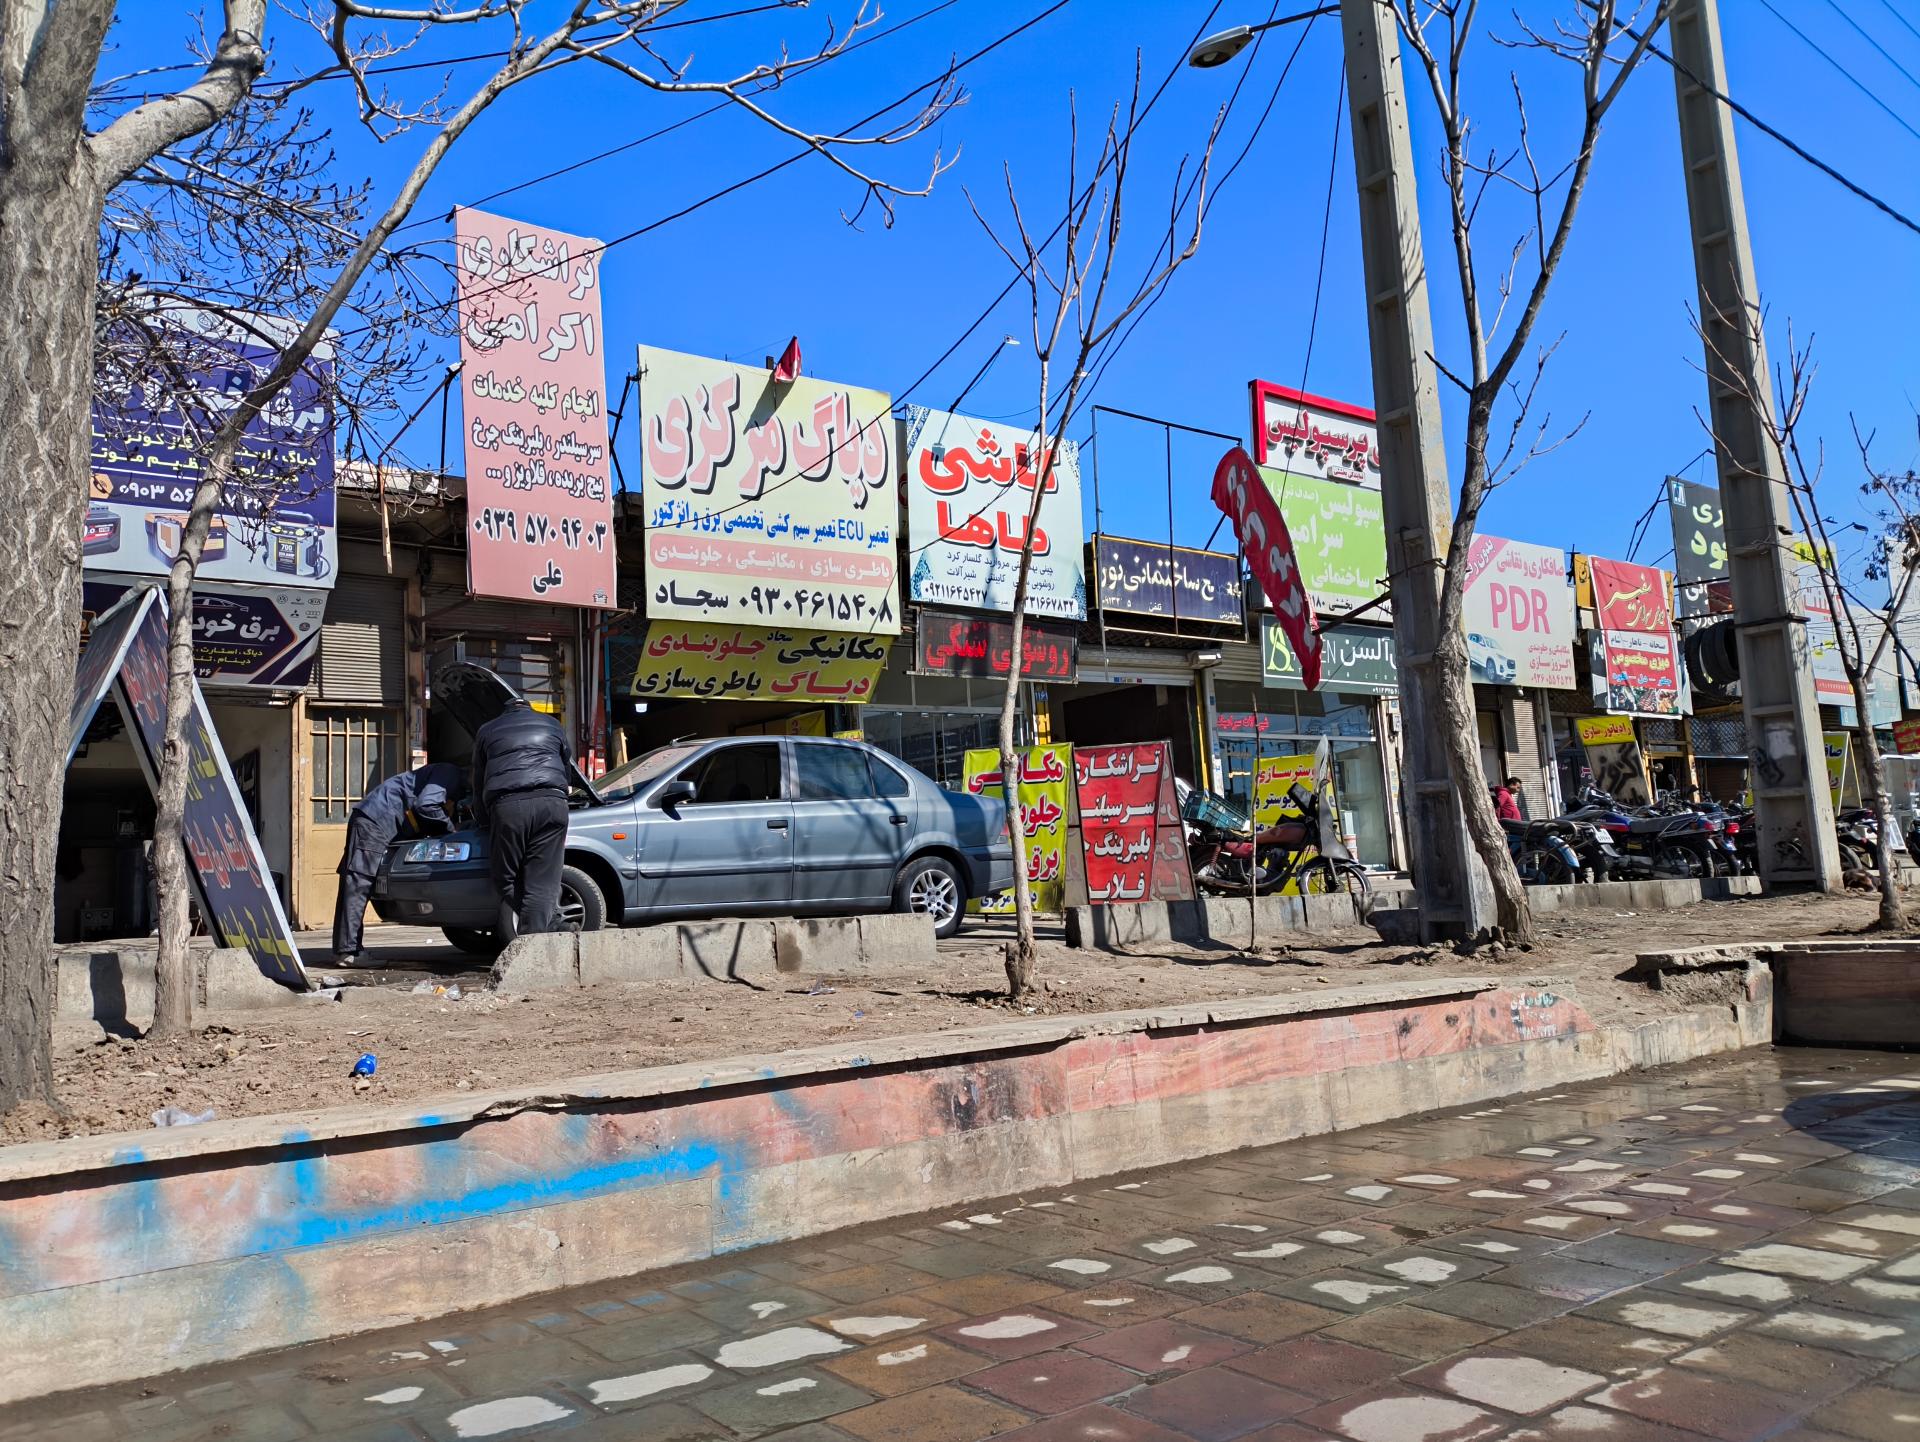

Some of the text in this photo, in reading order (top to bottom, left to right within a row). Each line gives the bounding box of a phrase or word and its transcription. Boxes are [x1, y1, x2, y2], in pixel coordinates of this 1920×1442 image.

[472, 371, 599, 422] انجام کلیه خدمات
[472, 417, 500, 451] چرخ
[501, 421, 544, 456] بلبرینگ
[648, 373, 889, 510] دیاگ مرکزی
[1267, 411, 1368, 467] پرسپولیس
[513, 459, 546, 490] قلاویز
[919, 428, 1060, 495] کاشی
[503, 466, 512, 488] و
[692, 510, 699, 525] و
[702, 507, 721, 532] برق
[724, 508, 763, 535] تخصصی
[1320, 490, 1381, 528] سپولیس
[766, 512, 789, 538] کشی
[793, 521, 810, 541] سیم
[814, 518, 836, 543] تعمیر
[839, 519, 864, 541] ECU
[868, 525, 889, 548] تعمیر
[936, 500, 1050, 556] طاها
[654, 542, 722, 567] جلوبندی
[985, 557, 1010, 570] مروارید
[1497, 550, 1522, 572] نقاشی
[1524, 561, 1528, 576] و
[1529, 556, 1564, 579] صافکاری
[532, 559, 563, 593] علی
[845, 559, 890, 581] باطری
[1101, 552, 1124, 590] نور
[1123, 555, 1200, 592] ساختمانی
[1311, 562, 1370, 589] ساختمانی
[655, 579, 893, 623] ۰۹۳۰۴۶۱۵۴۰۸ سجاد
[1489, 582, 1550, 634] PDR
[190, 613, 281, 642] برق خود
[647, 630, 766, 661] جلوبندی
[777, 634, 886, 665] مکانیکی
[770, 671, 871, 702] دیاگ
[1258, 765, 1292, 783] سازی
[1094, 828, 1151, 864] بلبرینگ
